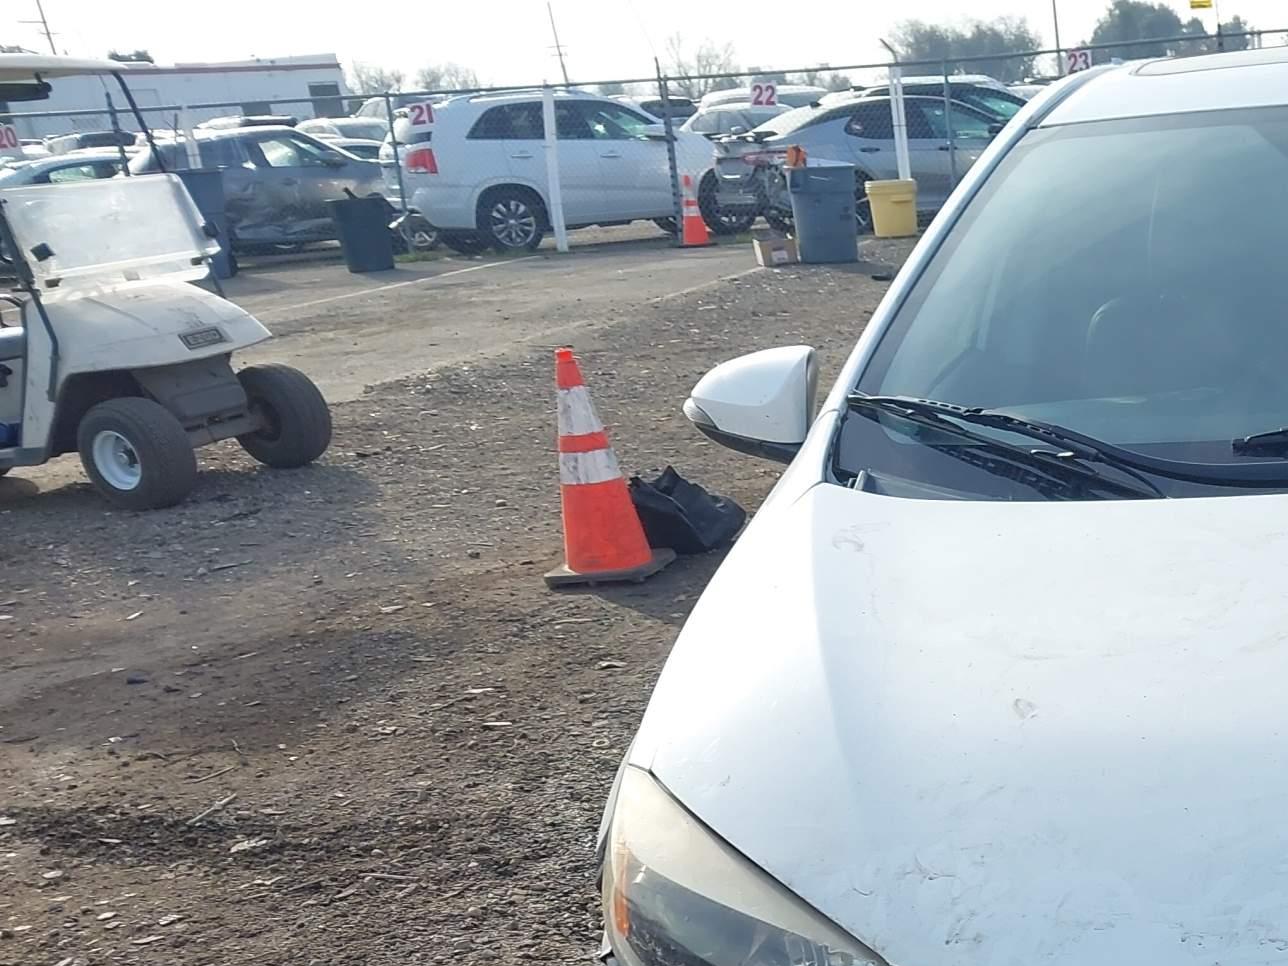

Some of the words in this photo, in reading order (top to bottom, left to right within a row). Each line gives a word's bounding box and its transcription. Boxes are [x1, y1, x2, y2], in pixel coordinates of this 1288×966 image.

[1067, 52, 1091, 75] 23
[752, 84, 777, 106] 22
[409, 103, 435, 126] 21
